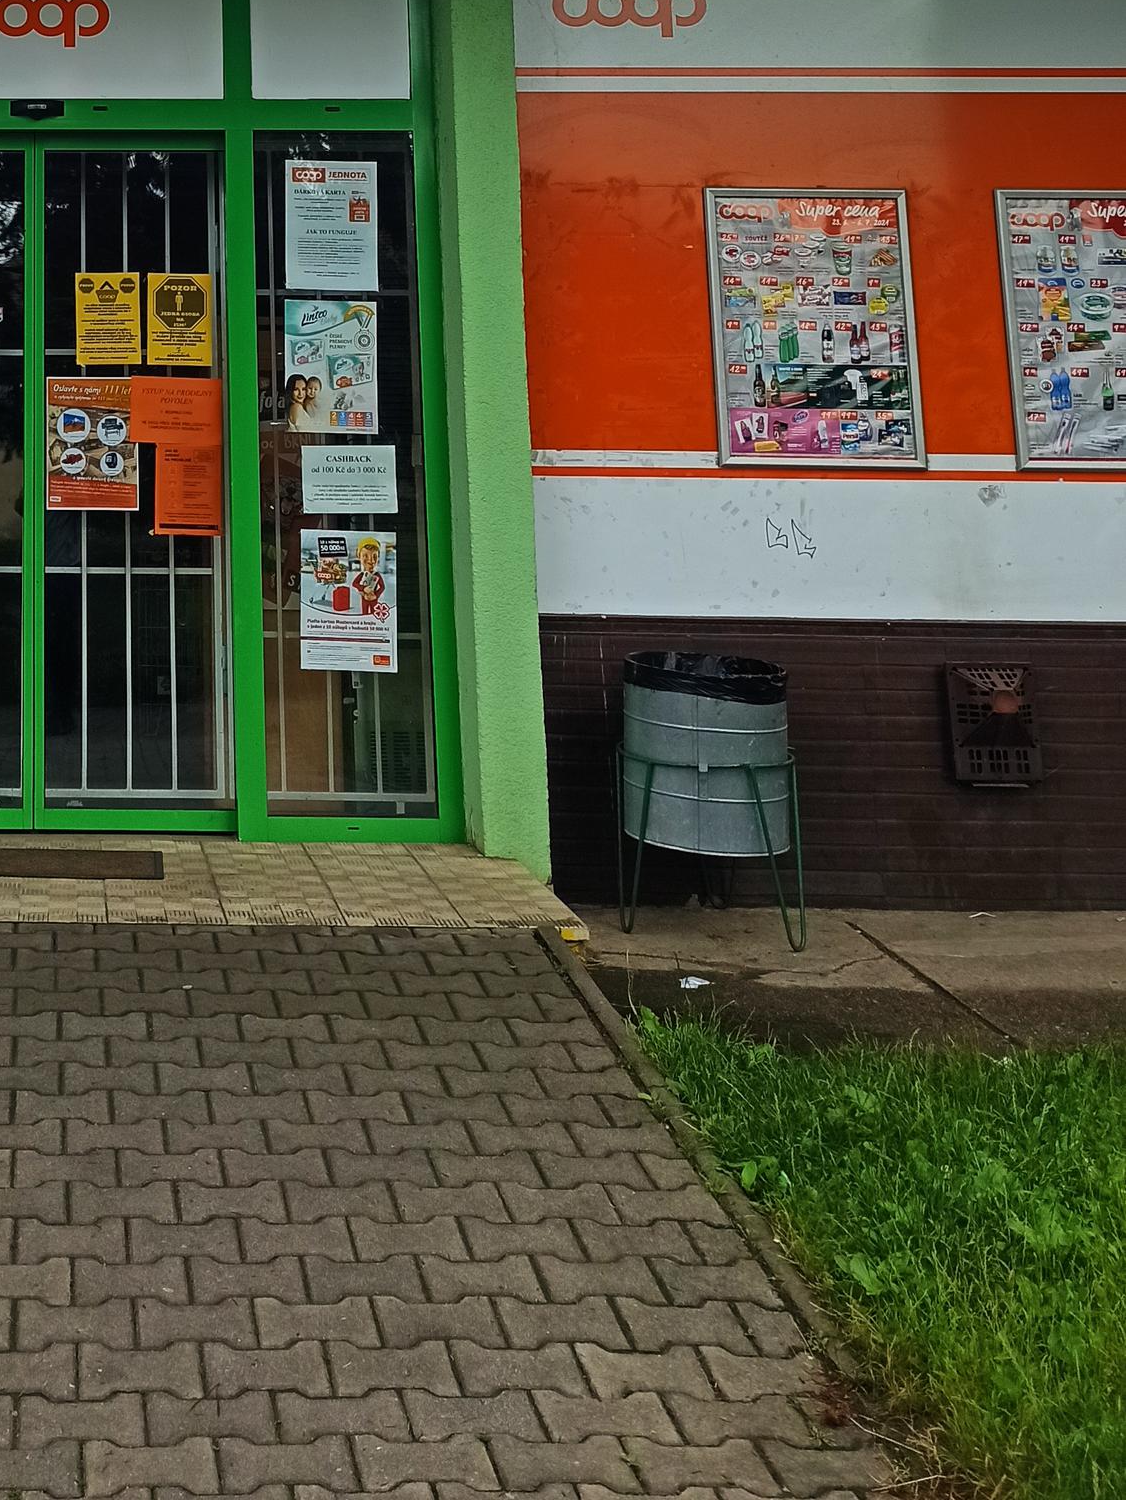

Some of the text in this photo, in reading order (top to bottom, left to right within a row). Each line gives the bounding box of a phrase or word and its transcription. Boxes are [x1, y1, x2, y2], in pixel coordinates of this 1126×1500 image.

[328, 171, 367, 179] JEDNOTA
[796, 202, 880, 221] Super cena
[1009, 212, 1066, 231] coop
[311, 466, 320, 474] od
[322, 466, 334, 474] 100
[335, 466, 345, 474] Kč
[347, 466, 355, 474] do
